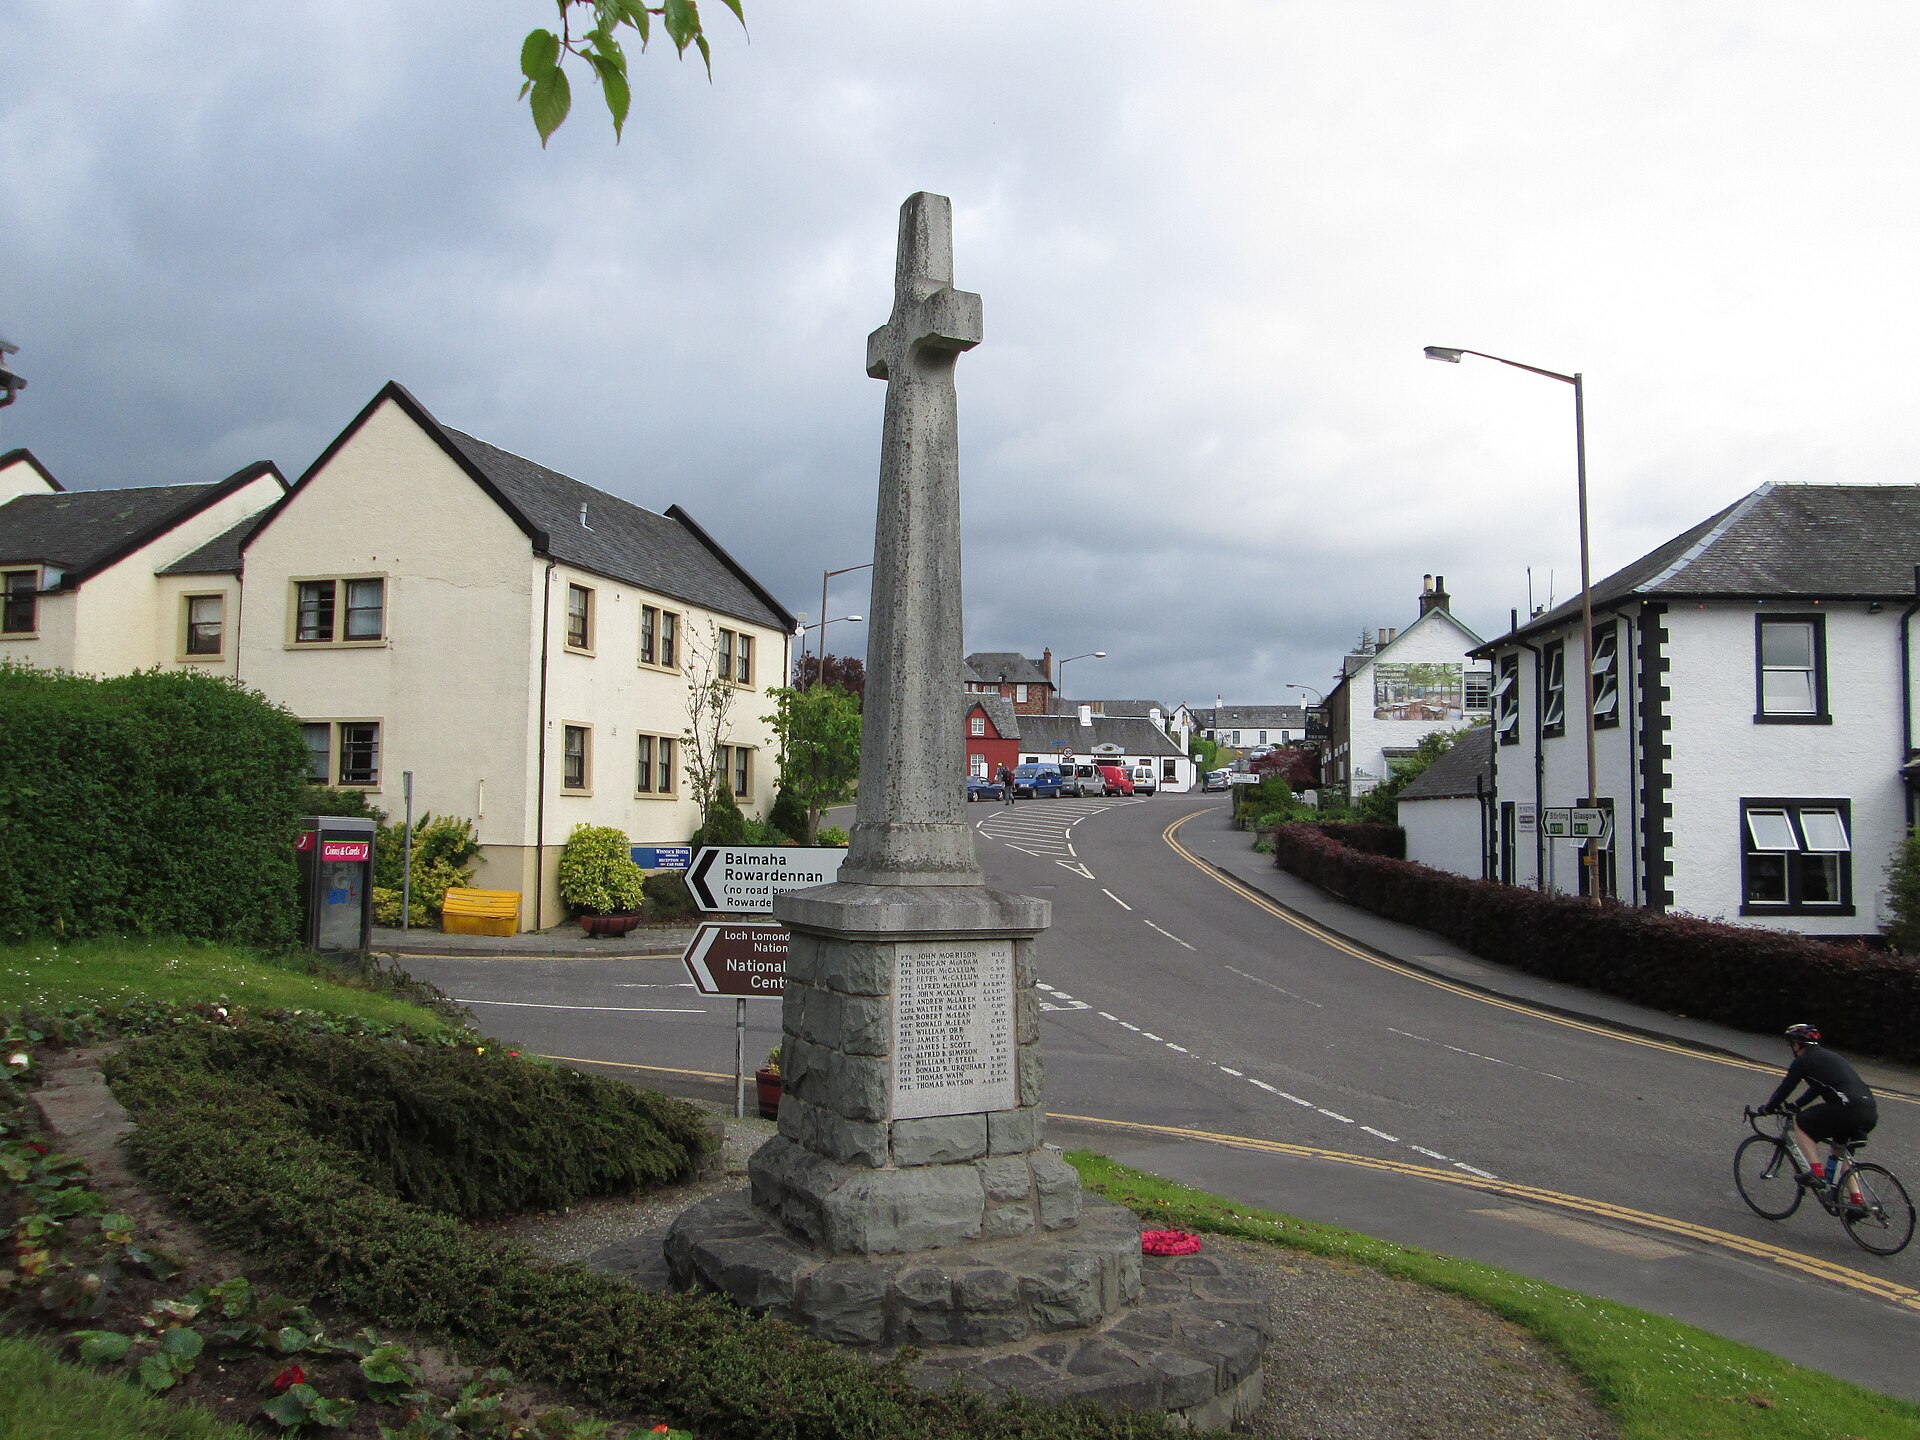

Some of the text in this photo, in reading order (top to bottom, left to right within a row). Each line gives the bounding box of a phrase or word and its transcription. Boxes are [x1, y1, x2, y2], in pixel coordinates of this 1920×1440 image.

[1550, 812, 1568, 820] Stirling
[1574, 812, 1596, 820] Glasgow
[726, 853, 786, 865] Balmaha
[725, 869, 823, 882] Rowardennan
[724, 885, 742, 895] (no
[746, 886, 768, 894] road
[727, 898, 772, 907] Rowarde
[725, 931, 791, 941] Loch Lomond
[754, 943, 788, 953] Nation
[727, 959, 786, 972] National
[751, 975, 788, 989] Cent
[952, 1063, 986, 1071] URQUHART
